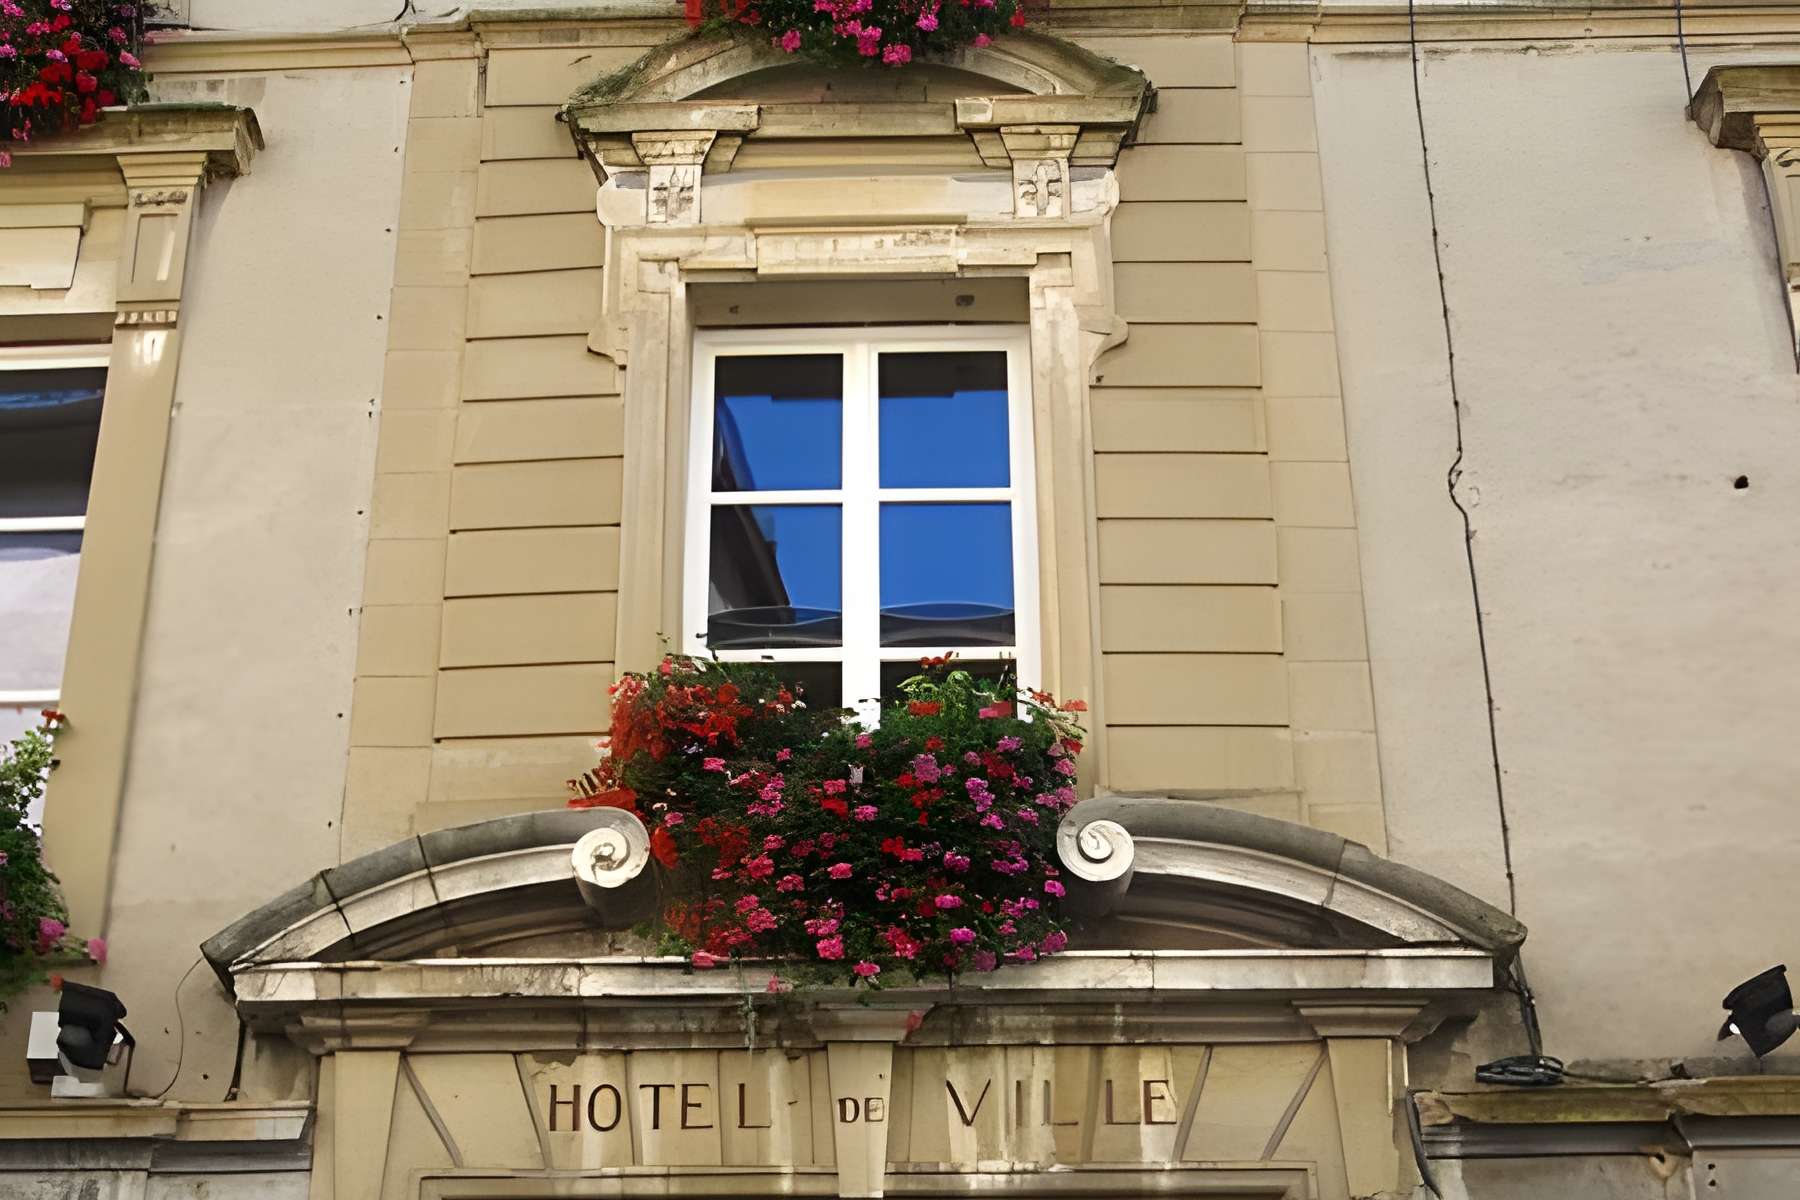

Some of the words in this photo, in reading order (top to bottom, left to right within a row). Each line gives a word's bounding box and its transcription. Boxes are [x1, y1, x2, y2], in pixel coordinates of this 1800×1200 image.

[549, 1082, 772, 1132] HOTEL
[838, 1097, 885, 1123] DE
[946, 1078, 1178, 1127] VILLE
